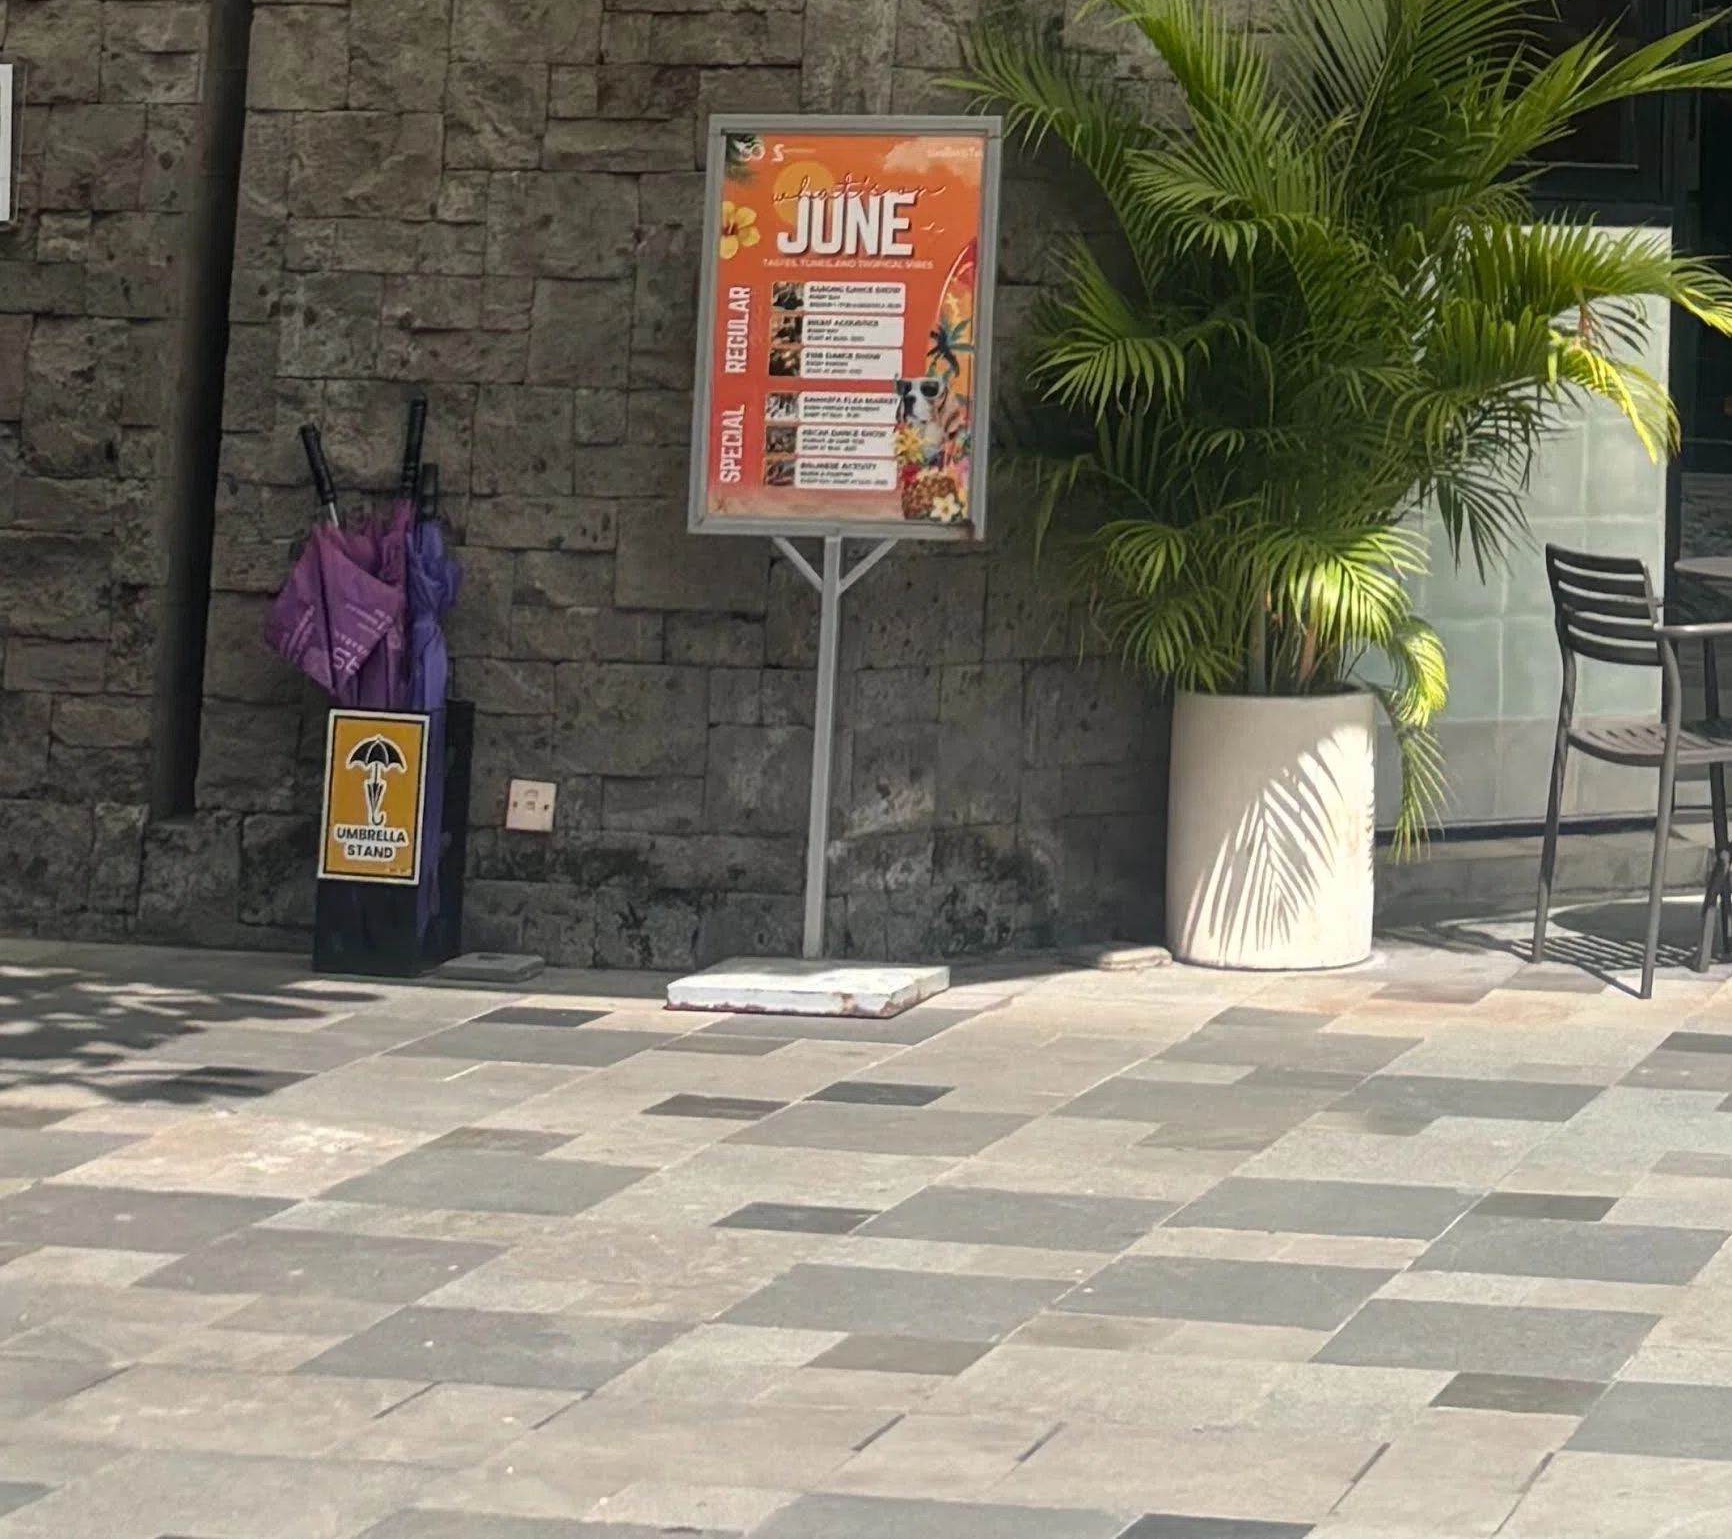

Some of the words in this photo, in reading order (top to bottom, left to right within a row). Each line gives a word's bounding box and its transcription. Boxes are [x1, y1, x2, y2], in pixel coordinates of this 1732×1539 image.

[776, 189, 917, 257] JUNE
[724, 285, 752, 374] REGULAR
[719, 403, 746, 484] SPECIAL
[336, 826, 406, 844] UMBRELLA
[347, 843, 393, 859] STAND
